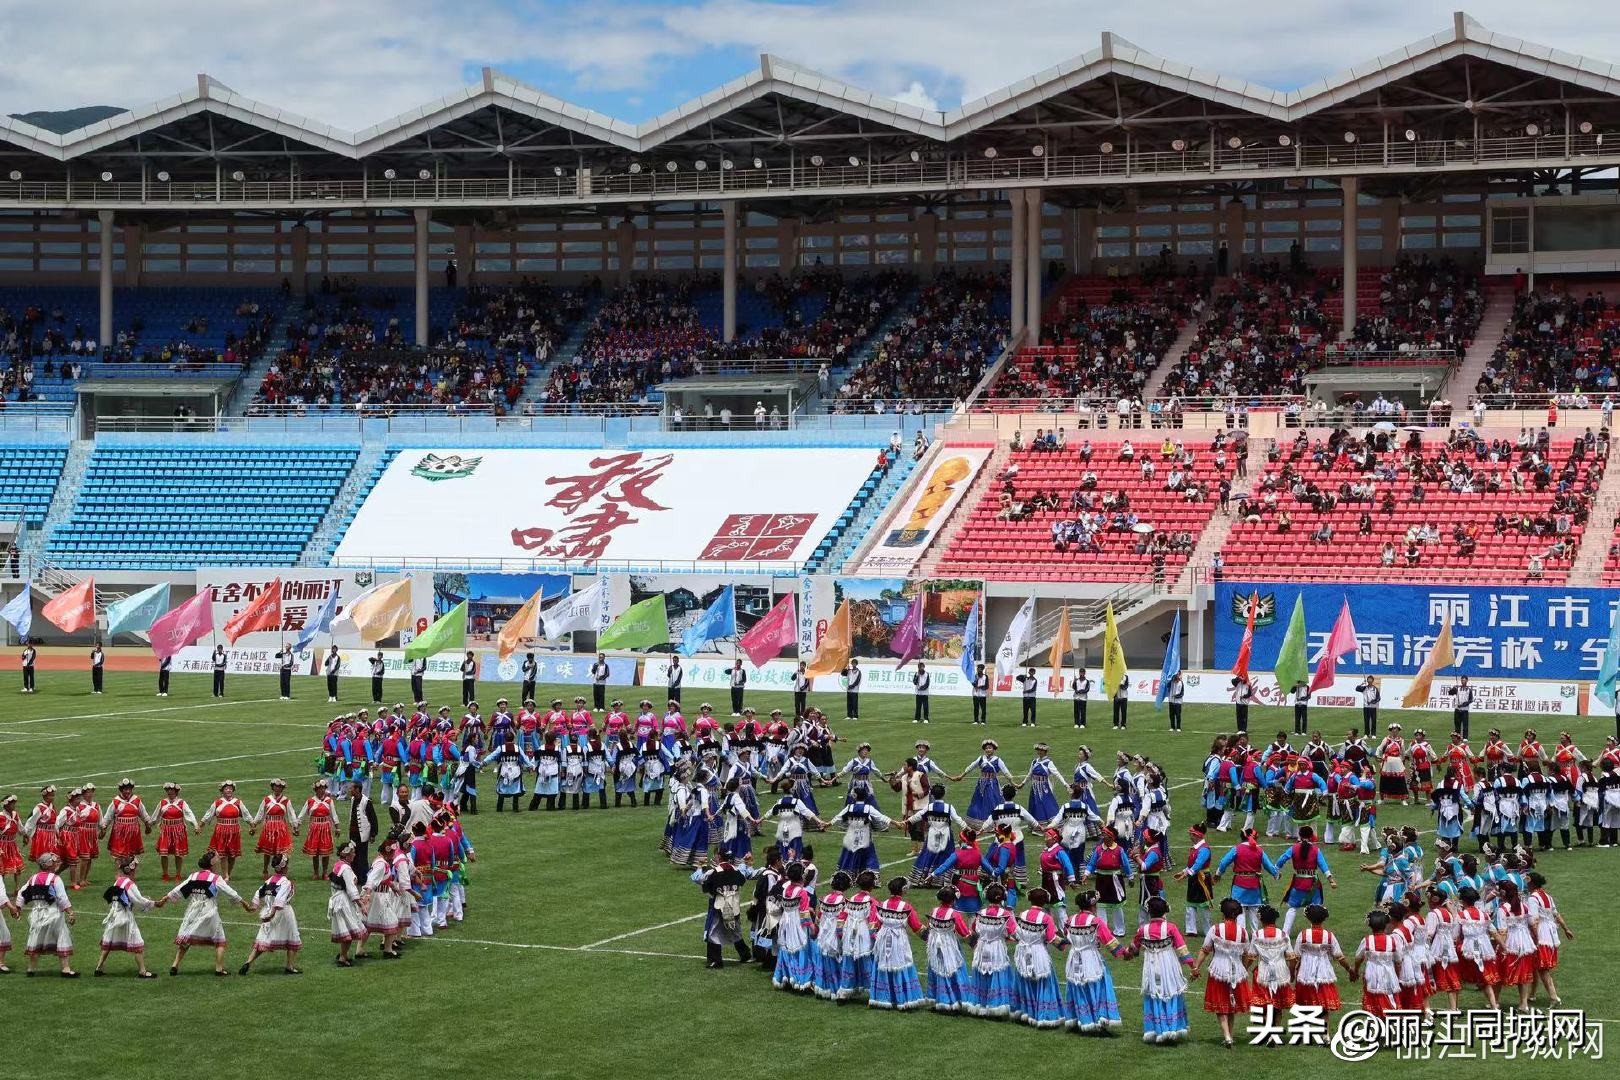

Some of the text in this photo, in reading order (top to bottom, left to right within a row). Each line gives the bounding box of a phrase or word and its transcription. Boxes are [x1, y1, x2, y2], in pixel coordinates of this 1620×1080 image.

[204, 578, 344, 603] 在舍不的丽江
[802, 577, 814, 655] 舍不得的丽江
[1428, 593, 1619, 628] 丽江市
[217, 650, 269, 661] 江市古城区
[868, 669, 960, 685] 丽江市足协会
